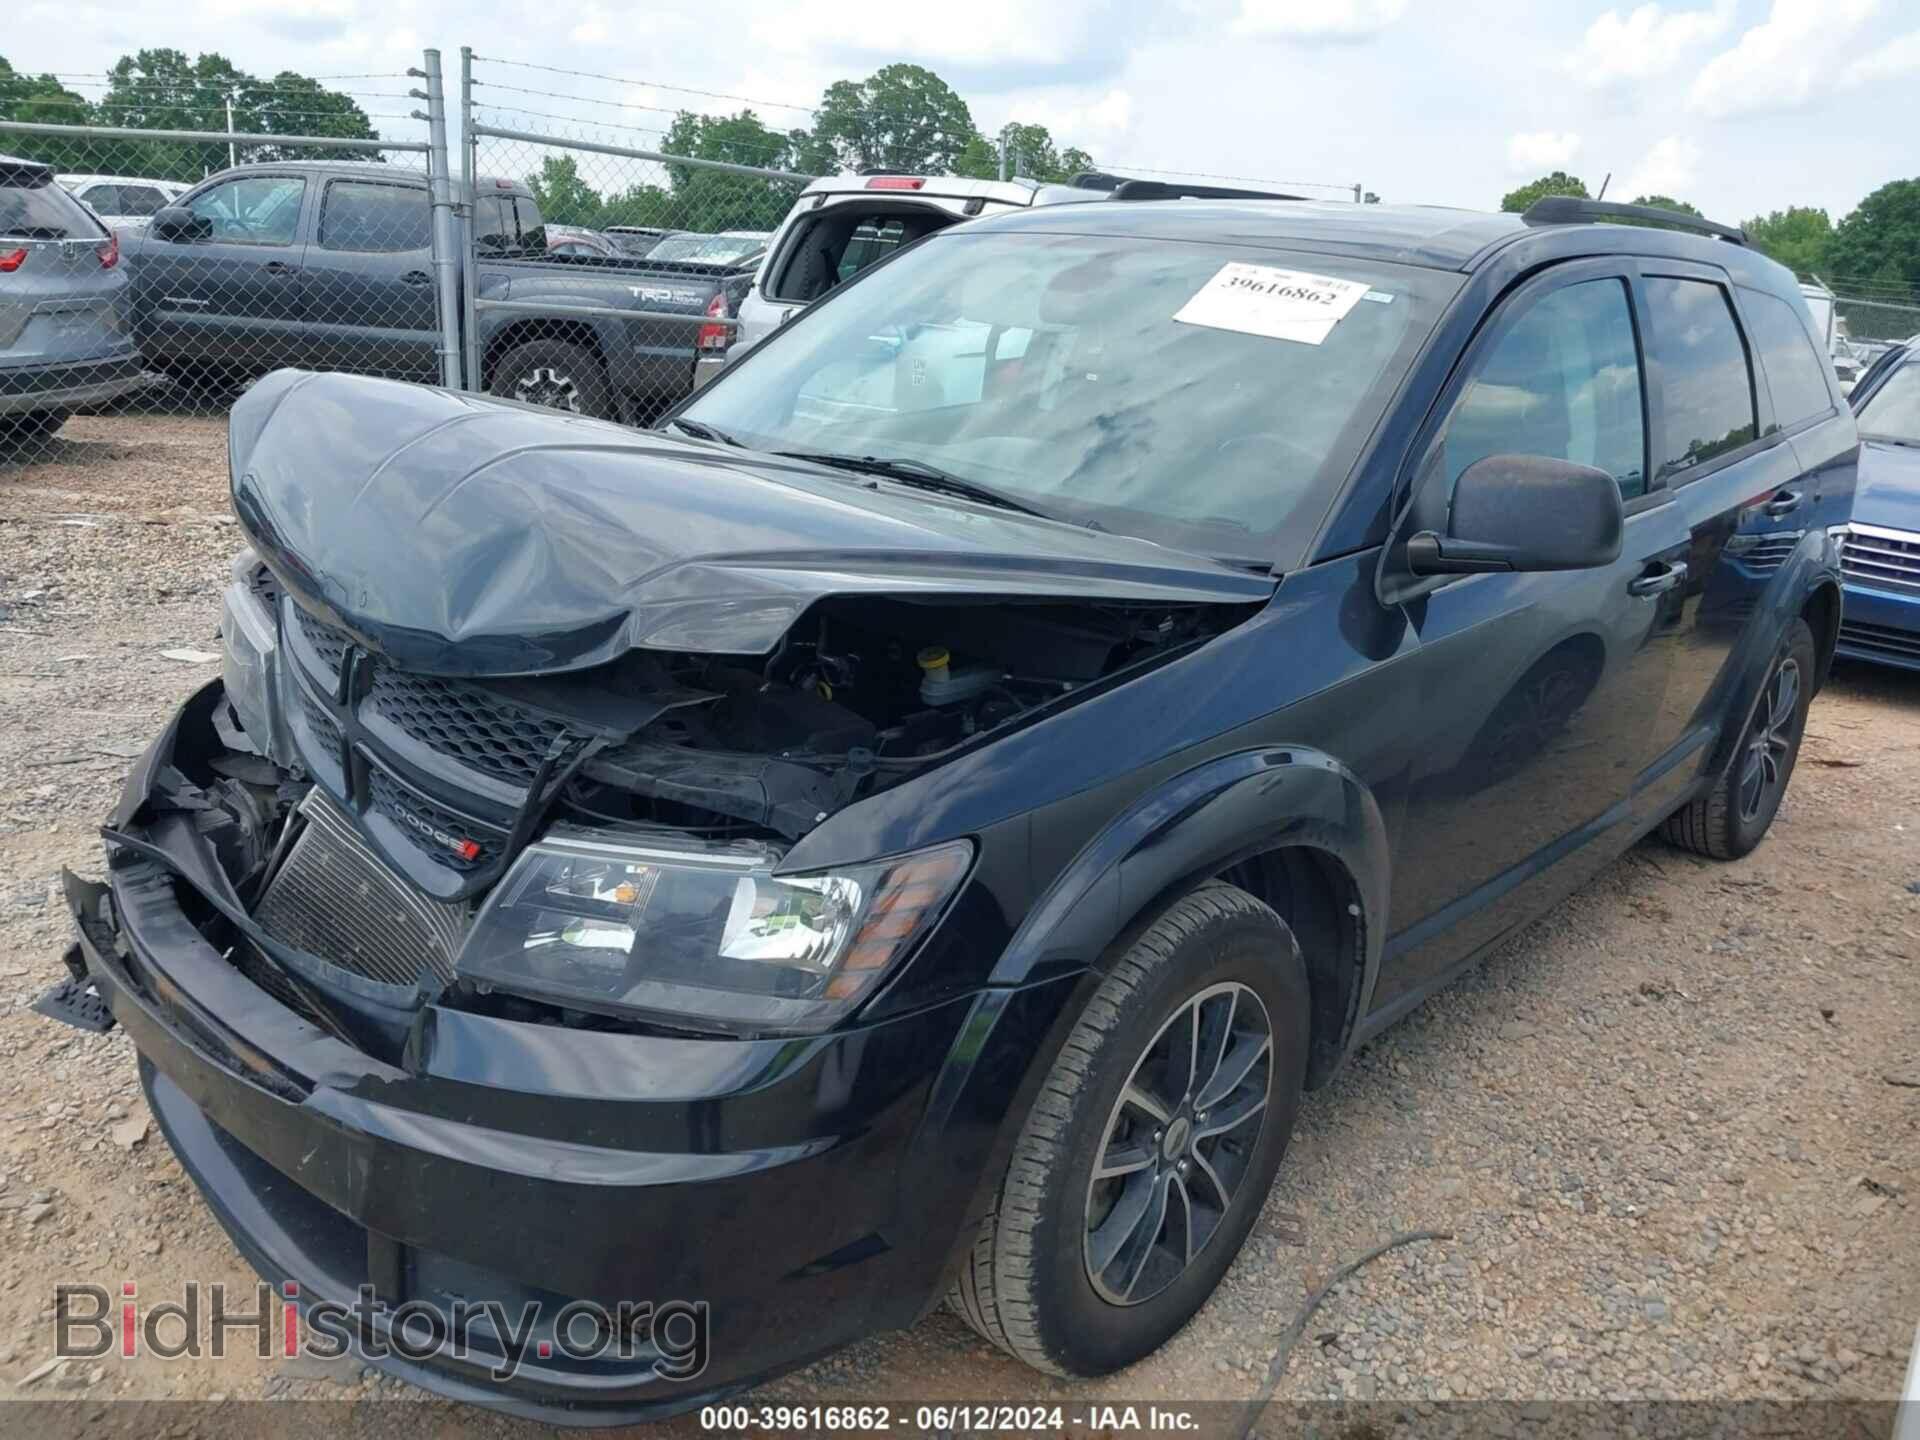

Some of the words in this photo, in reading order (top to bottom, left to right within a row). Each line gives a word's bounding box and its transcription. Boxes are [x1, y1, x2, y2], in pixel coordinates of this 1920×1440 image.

[628, 286, 673, 303] TRD
[1221, 276, 1337, 305] 39616862
[394, 803, 465, 852] DODGE
